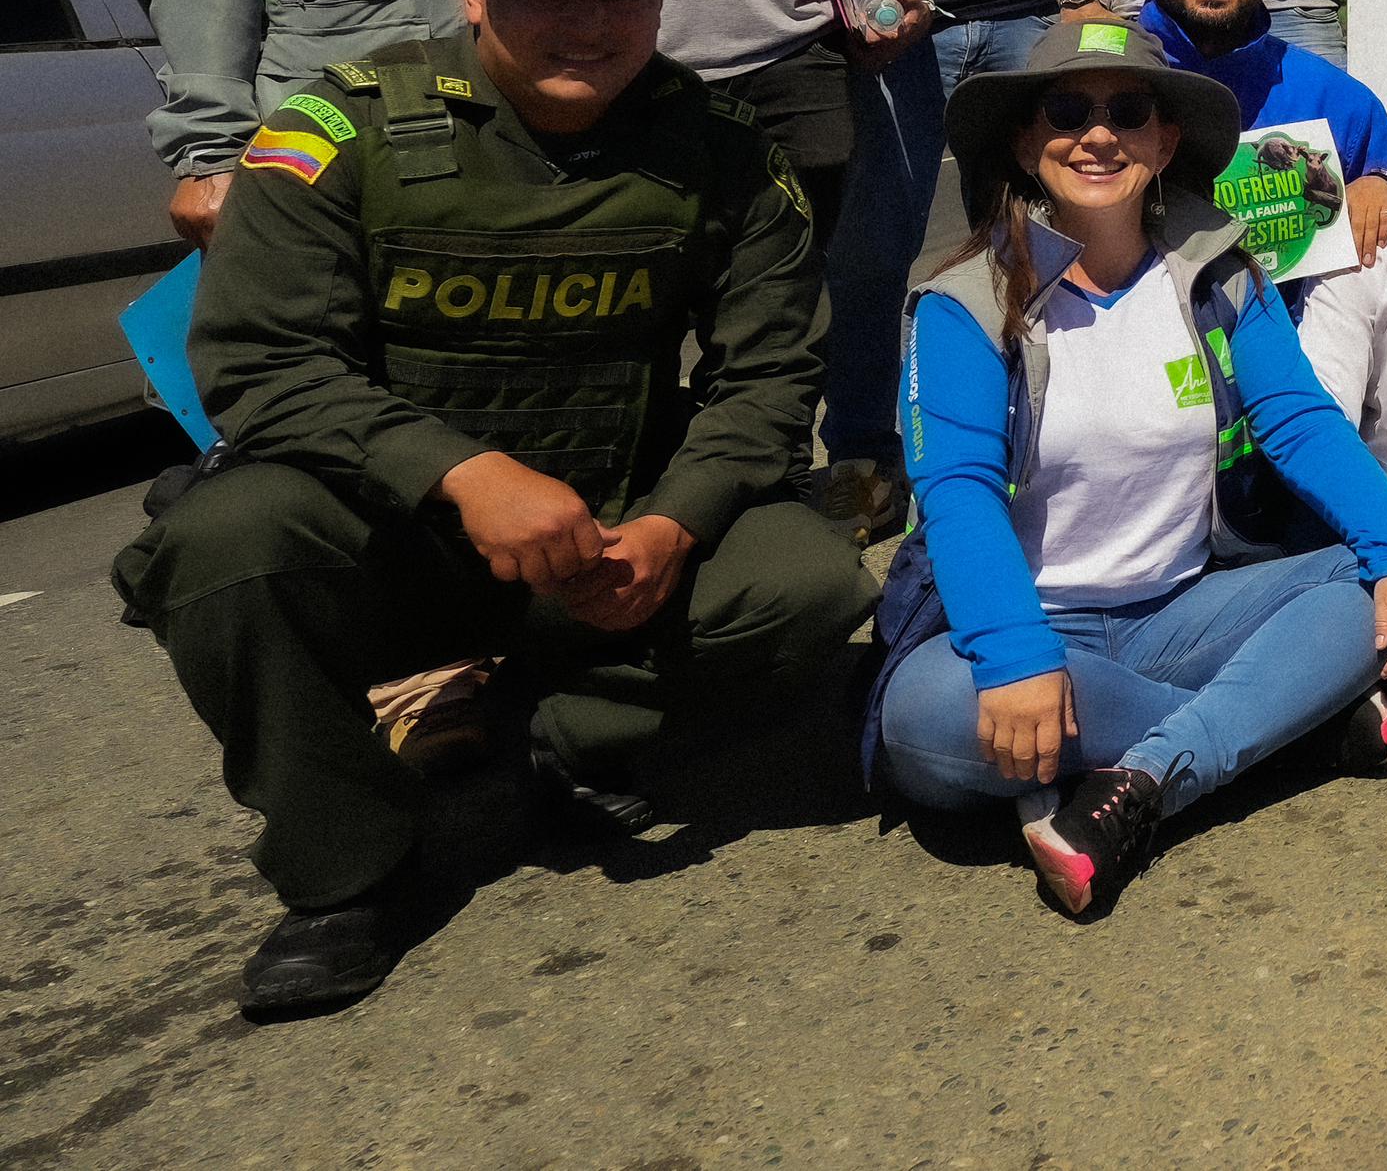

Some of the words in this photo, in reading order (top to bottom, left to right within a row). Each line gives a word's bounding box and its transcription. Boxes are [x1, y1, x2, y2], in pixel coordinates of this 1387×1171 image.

[1239, 170, 1301, 205] FRENO
[1239, 211, 1252, 221] LA
[1256, 201, 1297, 217] FAUNA
[1244, 214, 1304, 247] ESTRE!
[384, 265, 652, 320] POLICIA
